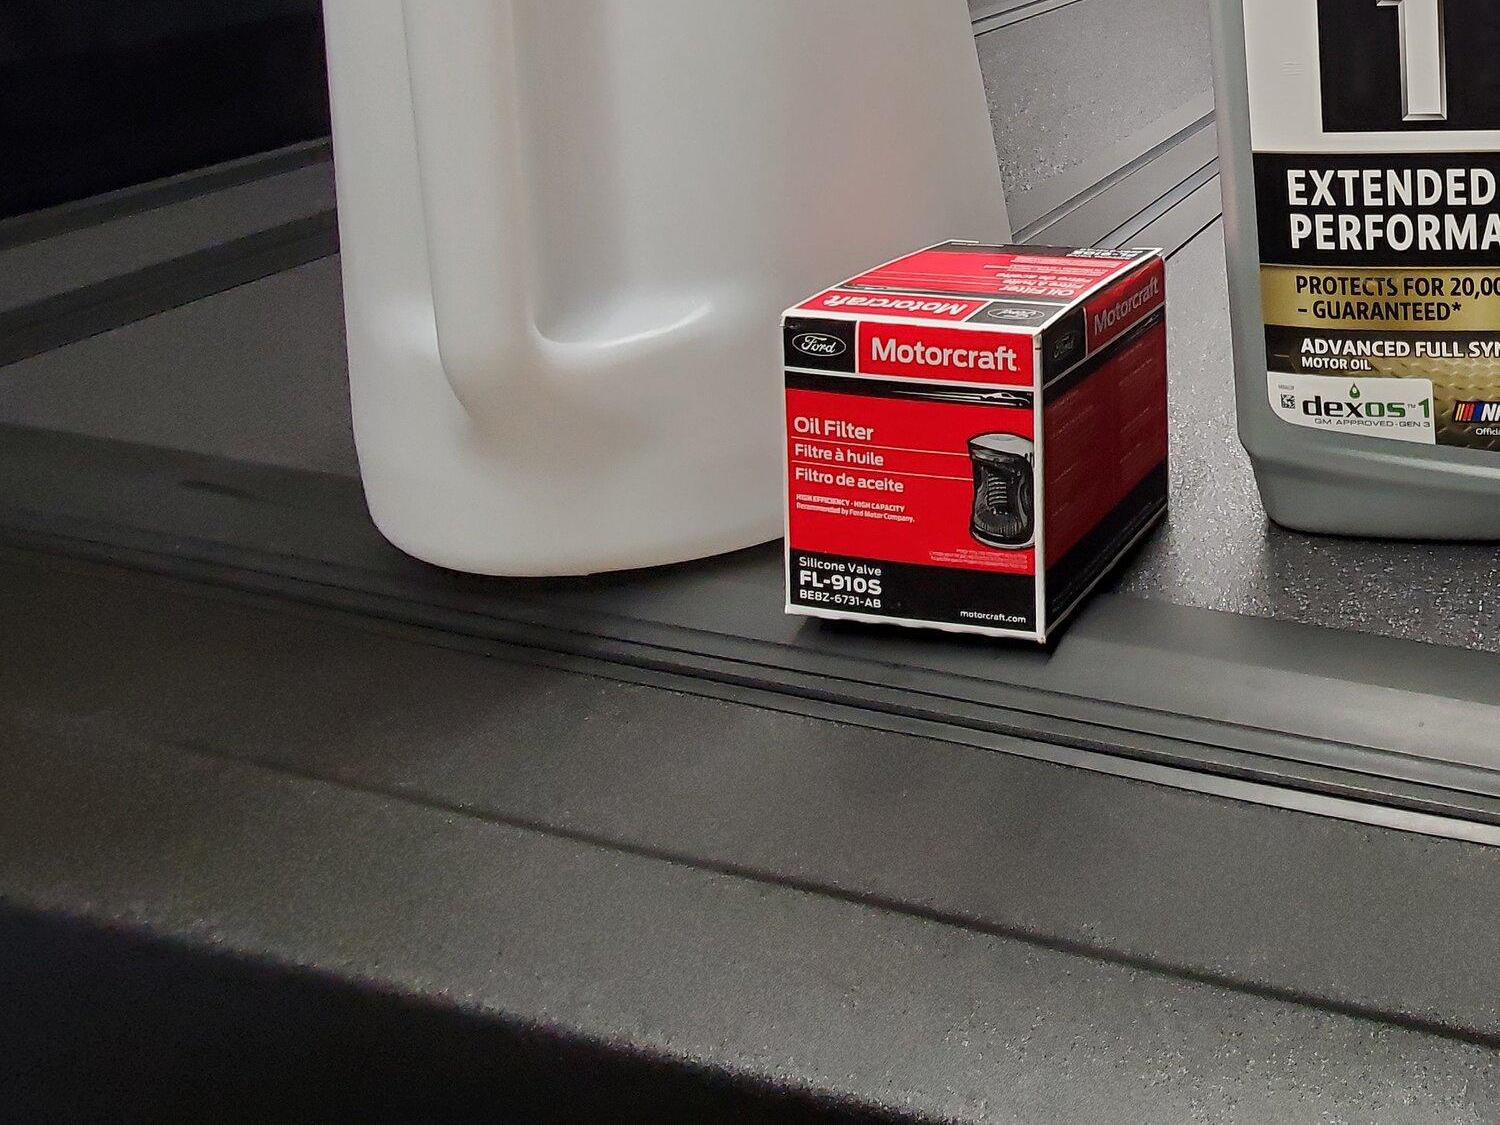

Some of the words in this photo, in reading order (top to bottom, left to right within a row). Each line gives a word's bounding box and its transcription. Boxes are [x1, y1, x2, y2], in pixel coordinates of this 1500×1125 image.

[1287, 169, 1497, 206] EXTENDED
[1043, 287, 1077, 297] Oil
[1295, 275, 1398, 296] PROTECTS
[1404, 277, 1444, 297] FOR
[823, 294, 970, 316] Motorcraft
[1093, 278, 1159, 336] Motorcraft
[801, 335, 836, 354] Ford
[871, 338, 1018, 372] Motorcraft
[1301, 338, 1410, 358] ADVANCED
[1415, 340, 1464, 358] FULL
[1301, 357, 1348, 371] MOTOR
[1351, 358, 1372, 371] OIL
[793, 416, 821, 435] Oil
[825, 420, 874, 441] Filter
[795, 443, 832, 460] Filtre
[835, 446, 844, 462] à
[846, 448, 884, 466] huile
[795, 467, 834, 485] Filtro
[835, 472, 855, 487] de
[857, 475, 904, 493] aceite
[854, 501, 871, 509] HIGH
[871, 503, 905, 513] CAPACITY
[799, 556, 845, 572] Silicone
[847, 562, 882, 577] Valve
[799, 570, 882, 596] FL-910S
[799, 589, 882, 609] BE8Z-6731-AB
[960, 610, 1026, 624] motorcraft.com
